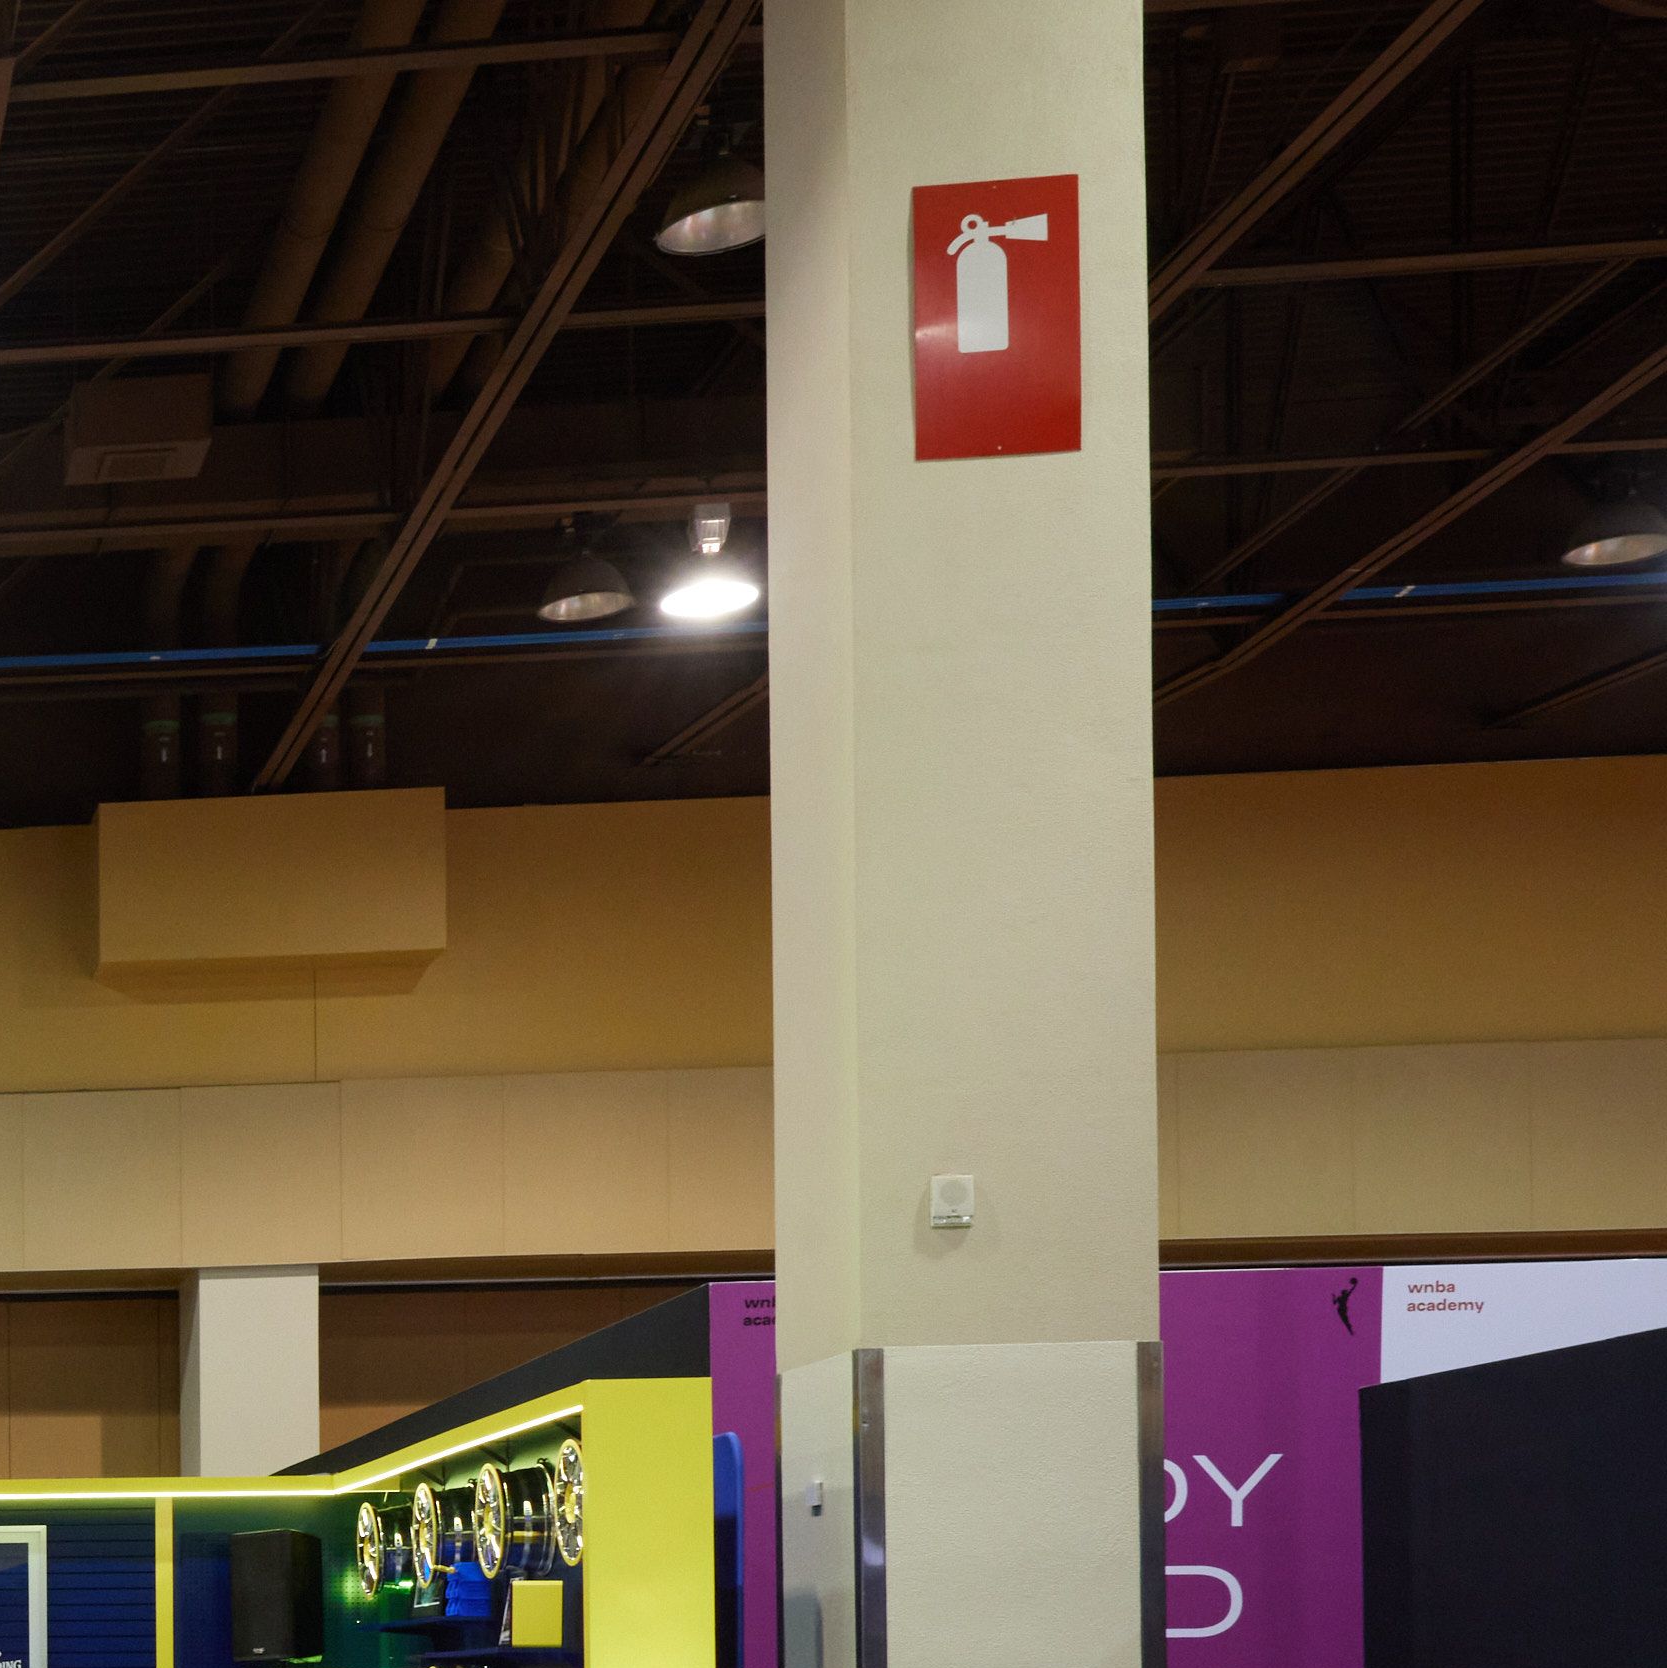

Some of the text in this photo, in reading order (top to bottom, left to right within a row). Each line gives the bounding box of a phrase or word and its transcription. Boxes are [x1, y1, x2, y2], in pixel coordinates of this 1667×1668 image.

[1407, 1280, 1455, 1293] wnba
[1407, 1298, 1484, 1314] academy
[743, 1316, 775, 1326] aca
